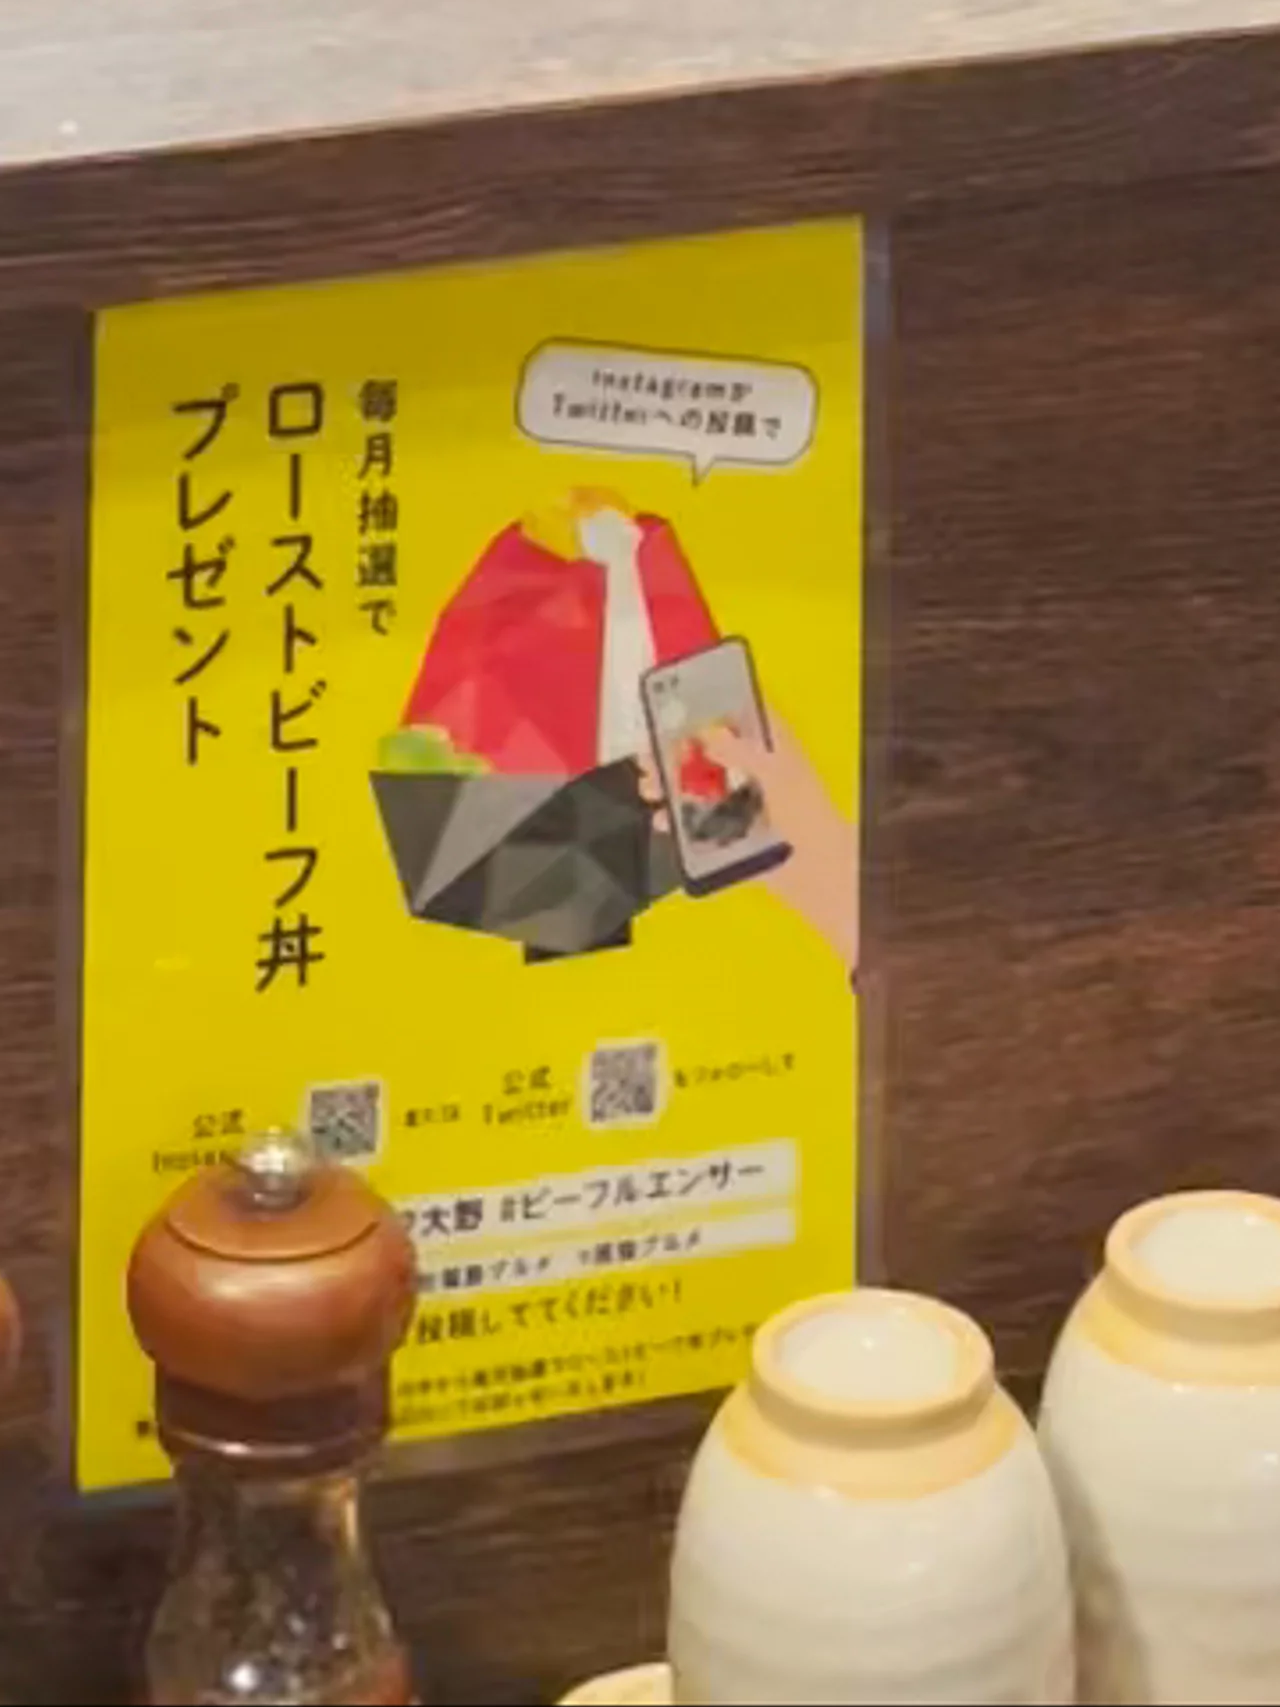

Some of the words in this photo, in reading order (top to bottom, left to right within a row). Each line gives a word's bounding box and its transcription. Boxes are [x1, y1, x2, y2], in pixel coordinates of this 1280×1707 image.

[166, 380, 239, 767] プレゼント
[356, 378, 399, 637] 毎月抽選で
[255, 381, 328, 992] ローストビーフ丼
[500, 1159, 765, 1223] #ビーフルエンサー
